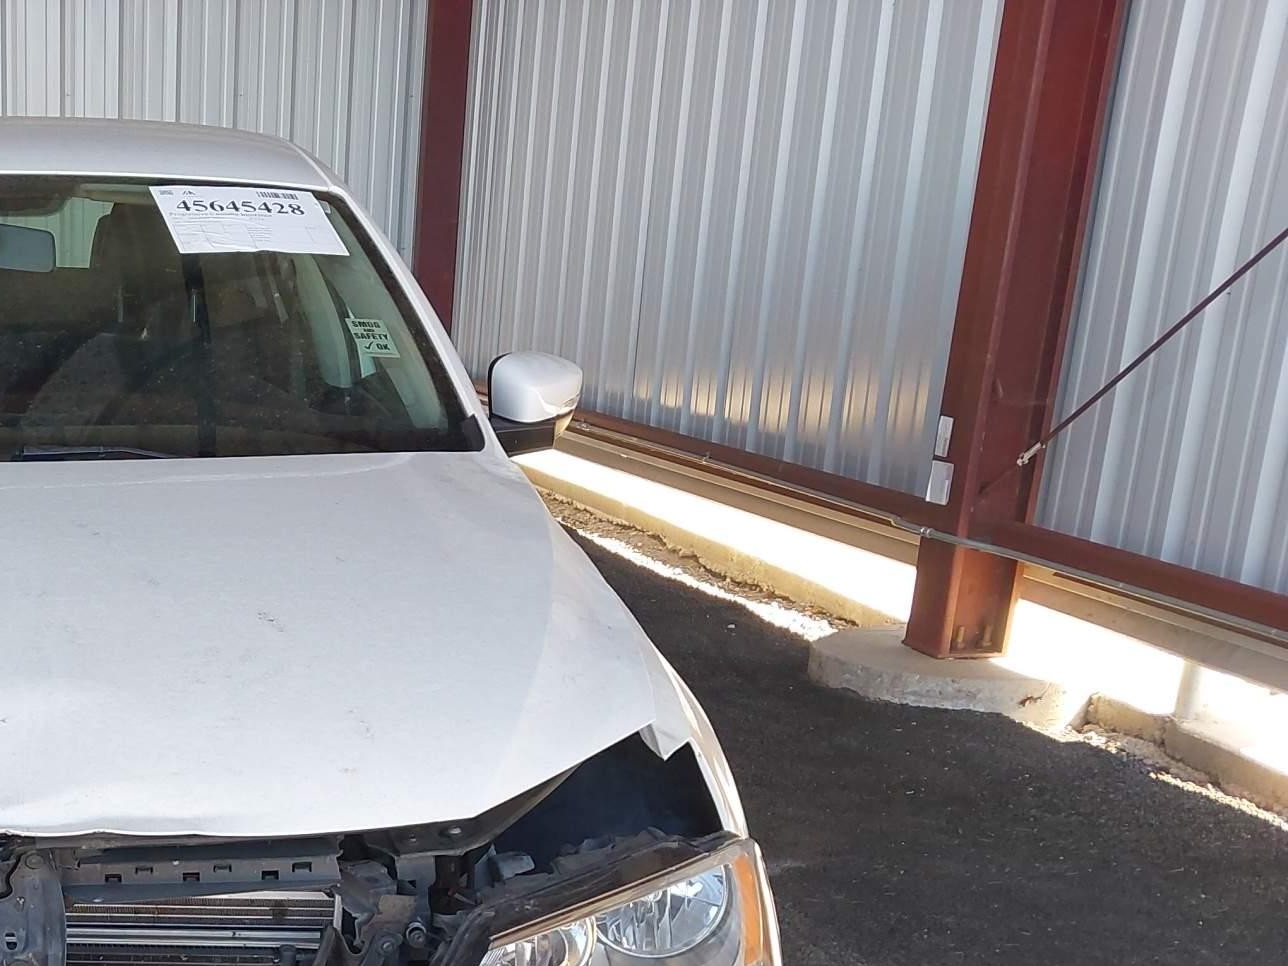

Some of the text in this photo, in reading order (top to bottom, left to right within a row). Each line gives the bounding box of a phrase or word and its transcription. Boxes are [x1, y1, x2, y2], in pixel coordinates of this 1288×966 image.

[176, 199, 305, 216] 45645428
[353, 332, 389, 341] SAFETY
[376, 342, 391, 351] OK
